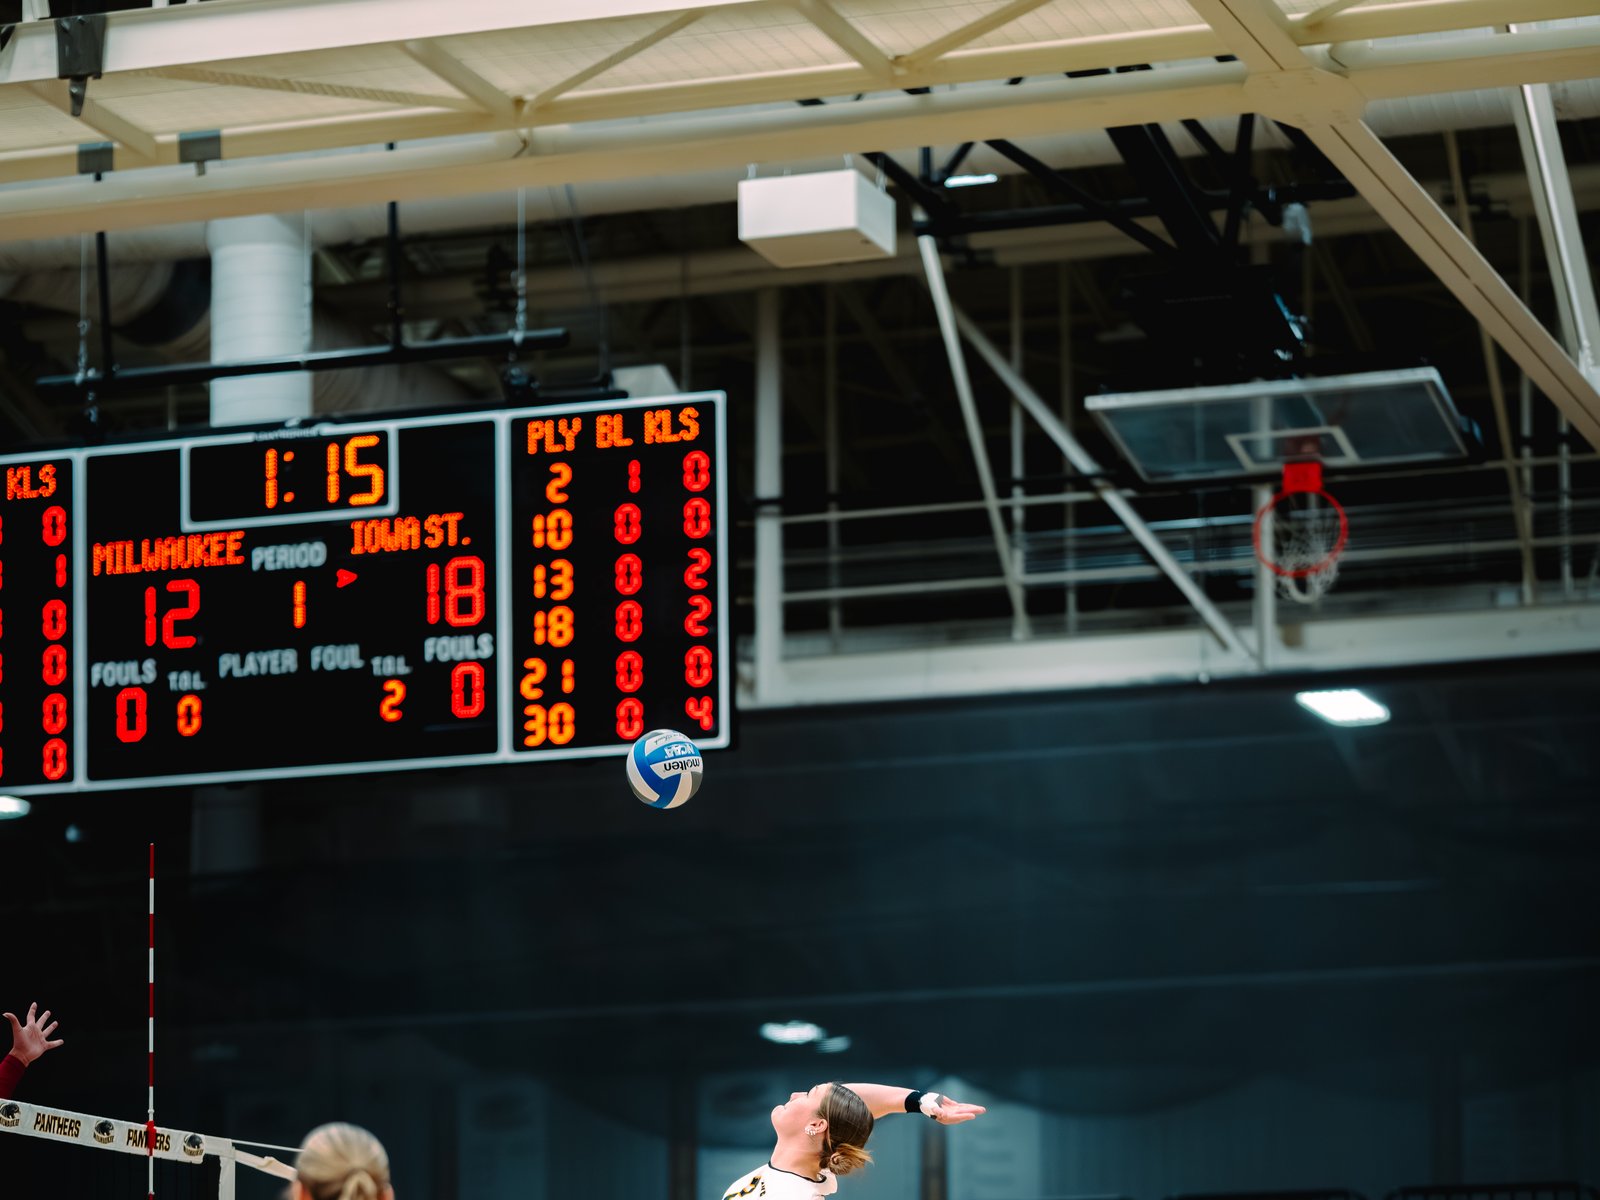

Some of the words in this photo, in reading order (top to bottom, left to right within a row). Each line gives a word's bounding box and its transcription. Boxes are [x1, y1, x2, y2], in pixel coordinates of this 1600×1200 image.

[527, 417, 583, 454] PLY
[596, 413, 634, 448] BL
[644, 407, 700, 444] KLS
[7, 464, 57, 500] KLS
[265, 435, 385, 509] 1:15
[546, 462, 573, 504] 2
[627, 459, 641, 493] 1
[683, 450, 711, 492] 0
[42, 505, 67, 546] 0
[532, 508, 574, 550] 10
[614, 503, 642, 544] 0
[683, 497, 711, 539] 0
[55, 554, 67, 588] 1
[93, 531, 246, 576] MILWAUKEE
[252, 542, 328, 571] PERIOD
[533, 558, 574, 601] 13
[615, 553, 643, 595] 0
[684, 548, 711, 590] 2
[293, 581, 306, 628] 1
[426, 556, 485, 627] 18
[42, 599, 67, 640] 0
[145, 579, 200, 649] 12
[534, 605, 575, 648] 18
[615, 600, 643, 642] 0
[684, 595, 712, 637] 2
[42, 644, 67, 686] 0
[219, 648, 298, 678] PLAYER
[311, 644, 364, 671] FOUL
[424, 633, 494, 662] FOULS
[90, 659, 157, 688] FOULS
[451, 662, 485, 718] 0
[616, 650, 644, 693] 0
[685, 645, 712, 688] 0
[42, 693, 67, 734] 0
[116, 687, 147, 743] 0
[177, 694, 202, 736] 0
[380, 679, 407, 722] 2
[524, 702, 576, 747] 30
[616, 697, 644, 740] 0
[685, 696, 713, 731] 4
[43, 738, 68, 780] 0
[664, 758, 701, 772] molten
[33, 1111, 82, 1138] PANTHERS
[126, 1128, 171, 1152] PANTERS
